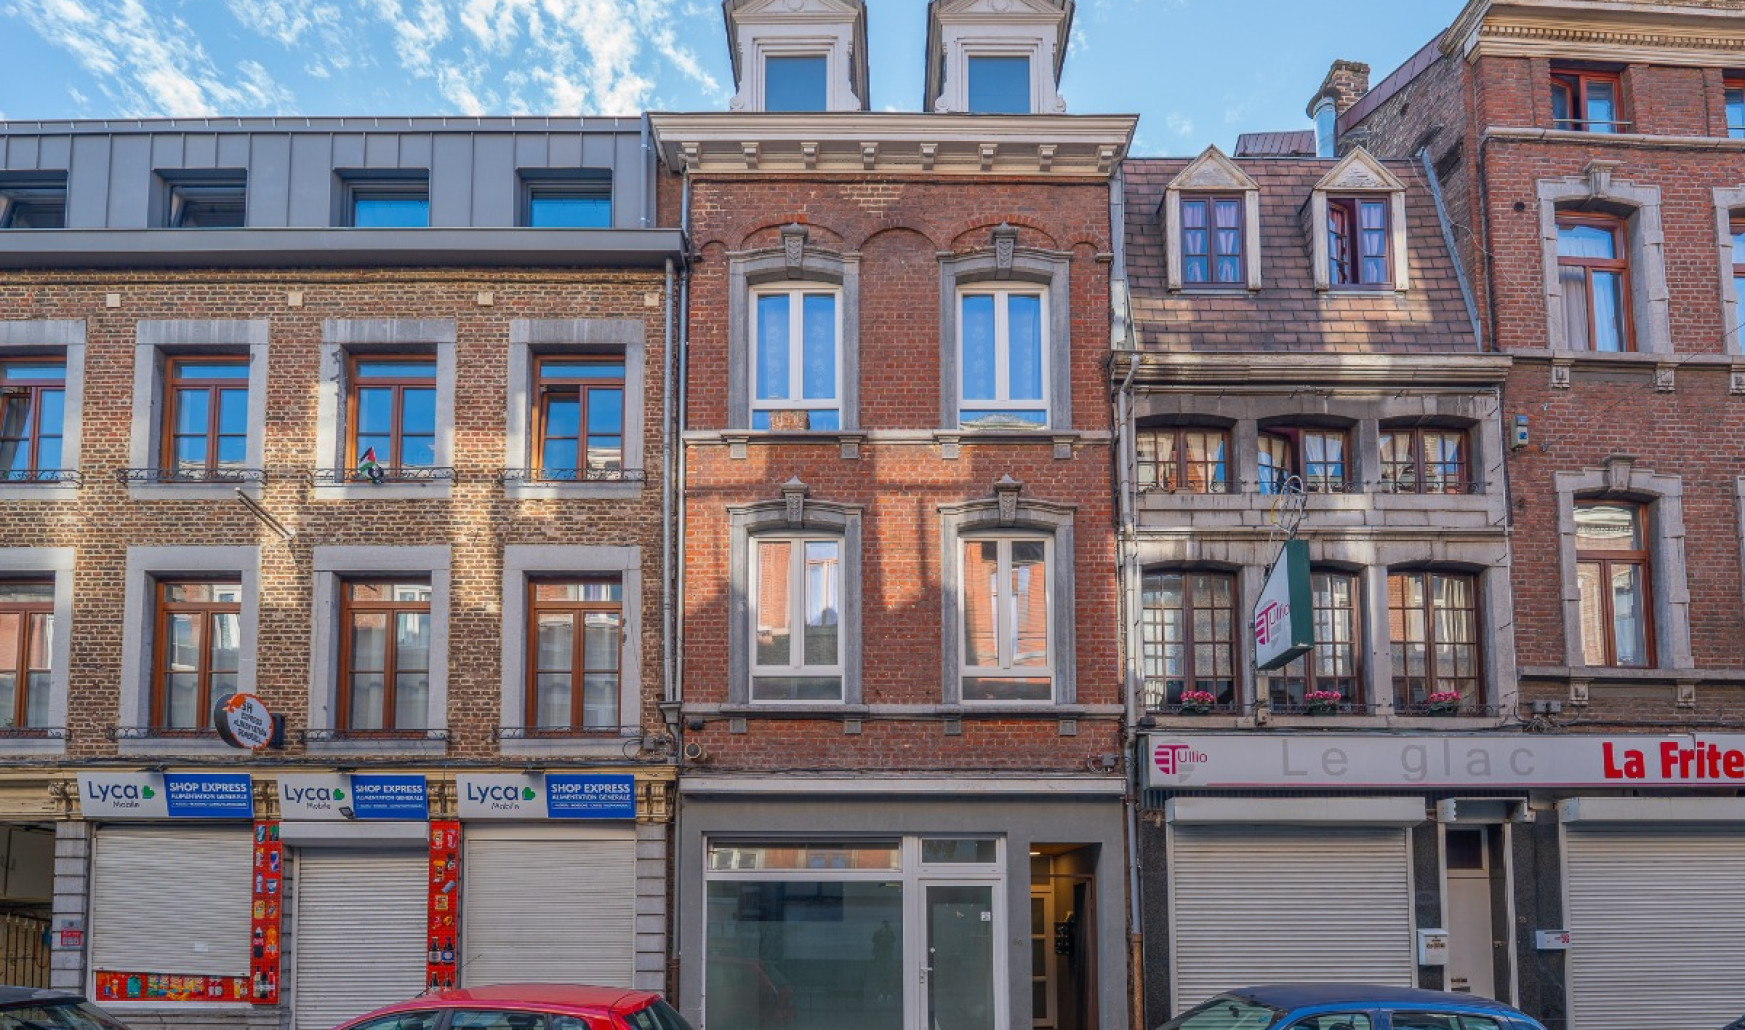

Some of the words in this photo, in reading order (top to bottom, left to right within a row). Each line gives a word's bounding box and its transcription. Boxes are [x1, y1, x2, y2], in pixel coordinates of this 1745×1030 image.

[1281, 739, 1348, 777] Le
[1401, 739, 1535, 783] glac
[1602, 741, 1645, 779] La
[88, 780, 139, 802] Lyca
[169, 782, 199, 792] SHOP
[201, 782, 247, 793] EXPRESS
[284, 784, 330, 803] Lyca
[355, 785, 381, 794] SHOP
[383, 785, 423, 794] EXPRESS
[467, 782, 519, 803] Lyca
[551, 783, 581, 794] SHOP
[583, 783, 631, 794] EXPRESS
